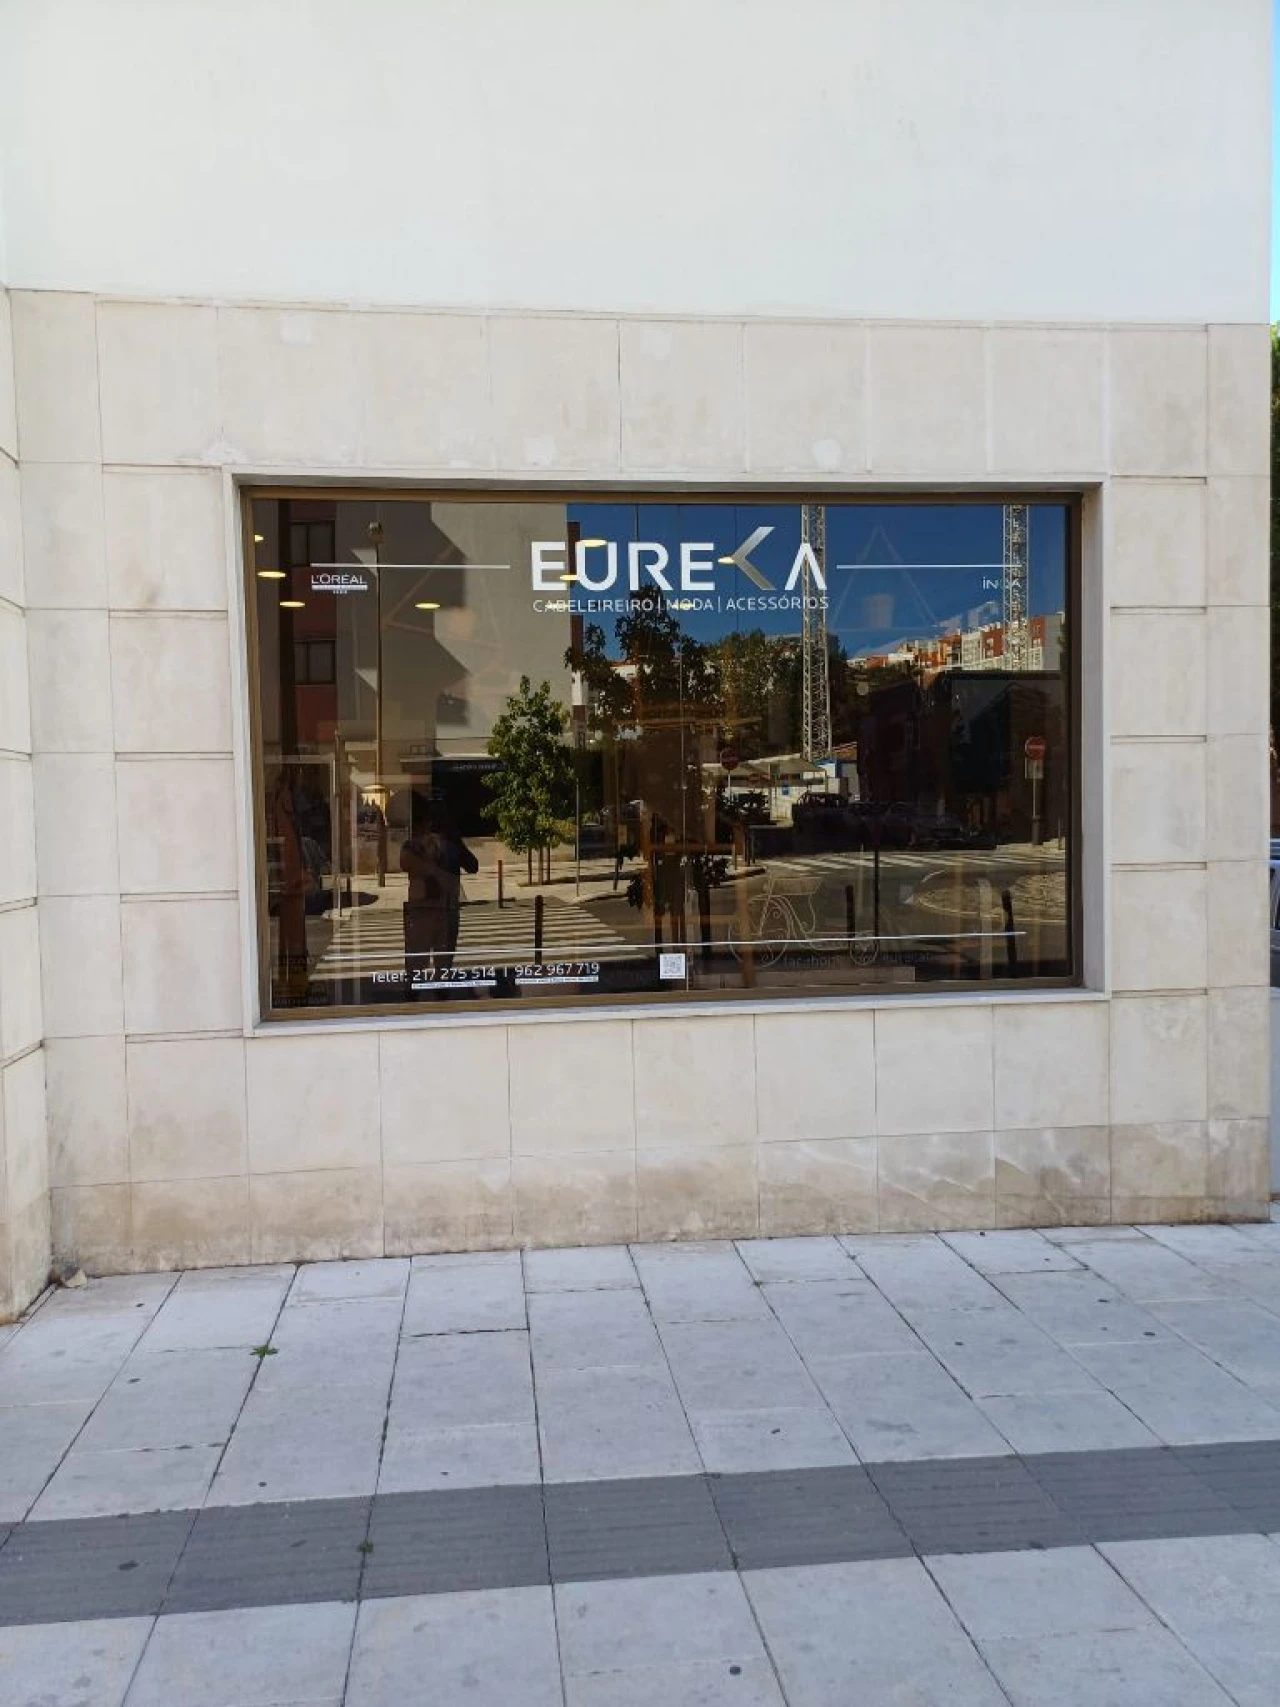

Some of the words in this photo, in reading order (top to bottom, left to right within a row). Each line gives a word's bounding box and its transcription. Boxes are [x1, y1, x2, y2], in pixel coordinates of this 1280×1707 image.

[531, 526, 827, 591] EUREKA
[532, 599, 654, 613] CABELEIREIRO
[666, 598, 714, 612] MODA
[726, 594, 829, 611] ACESSÓRIOS
[372, 971, 408, 983] Telef:
[412, 968, 436, 981] 217
[440, 968, 468, 980] 275
[471, 966, 496, 979] 514
[514, 964, 543, 977] 962
[547, 963, 573, 976] 967
[576, 961, 601, 974] 719
